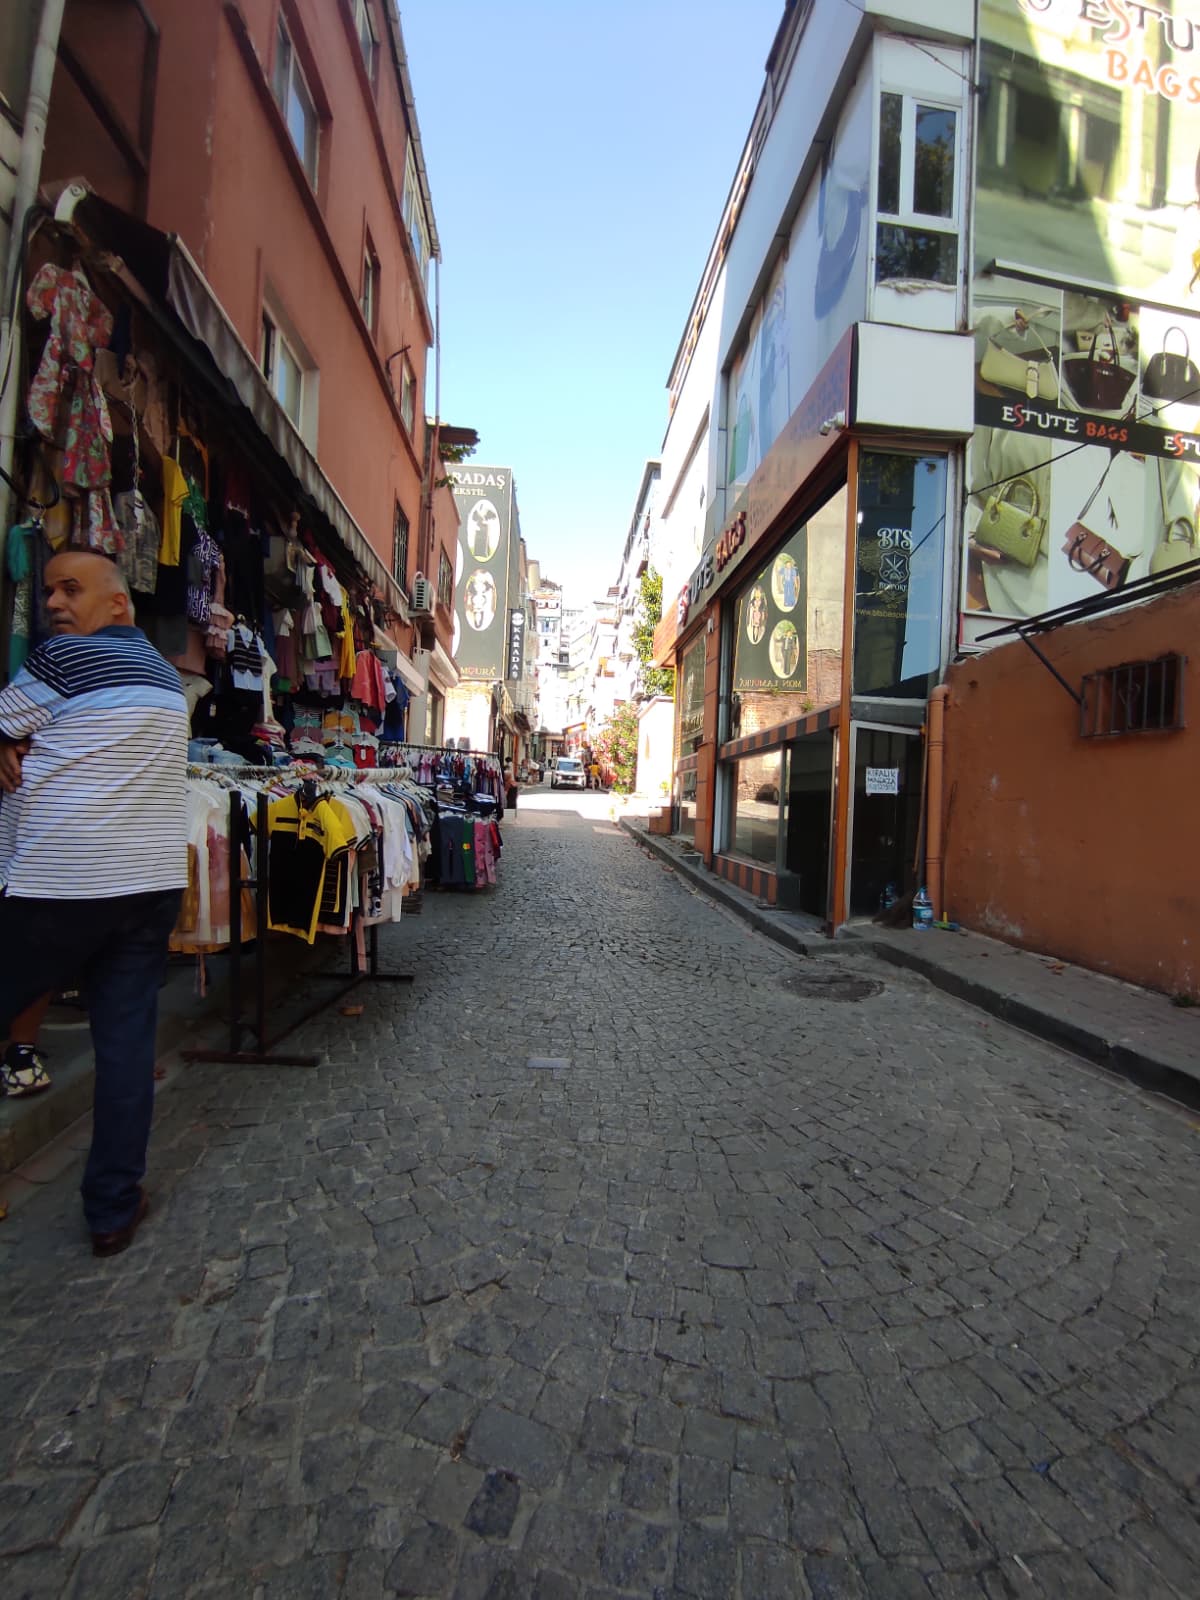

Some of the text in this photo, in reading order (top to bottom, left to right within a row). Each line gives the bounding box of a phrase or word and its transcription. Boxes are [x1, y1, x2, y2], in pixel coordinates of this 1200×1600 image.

[1078, 0, 1200, 51] ESTU
[1001, 403, 1129, 443] ESTUTE BAGS
[876, 527, 913, 550] BTS
